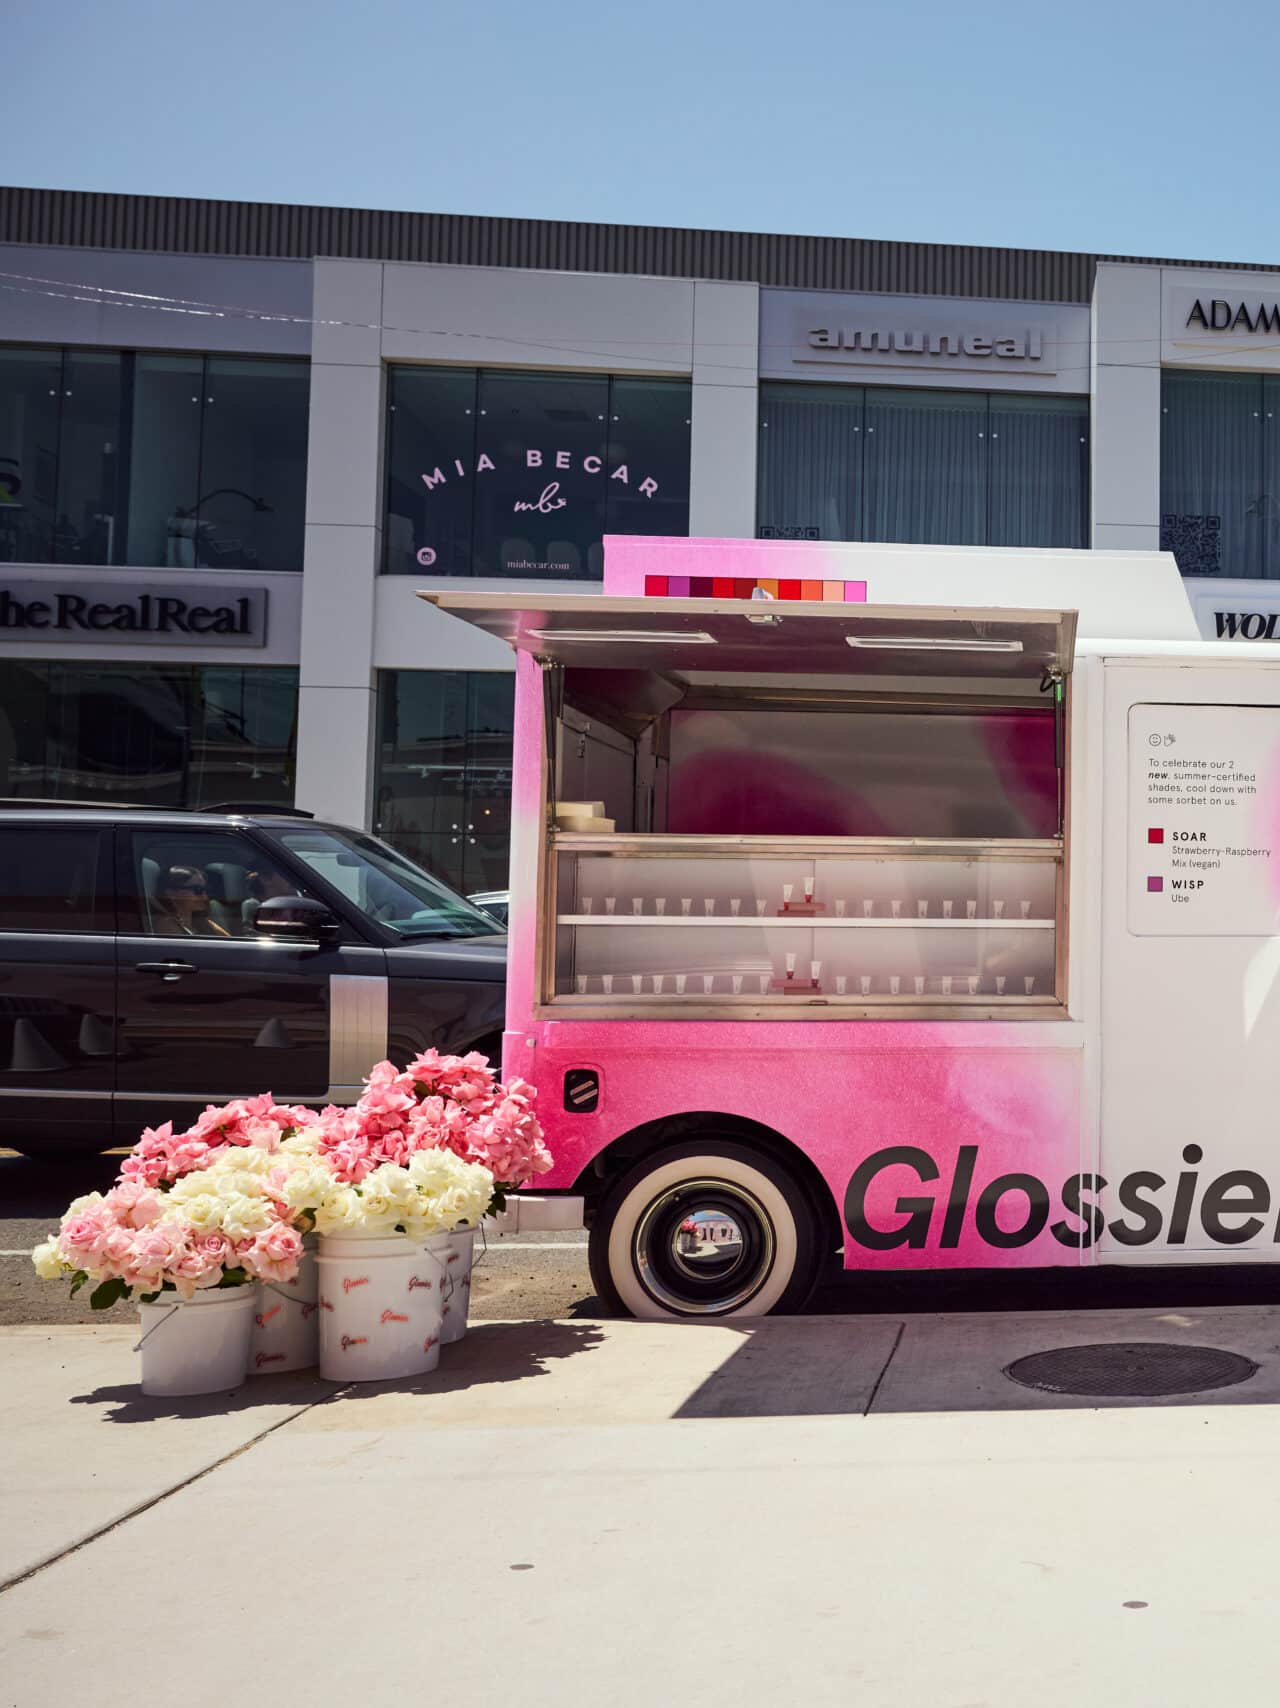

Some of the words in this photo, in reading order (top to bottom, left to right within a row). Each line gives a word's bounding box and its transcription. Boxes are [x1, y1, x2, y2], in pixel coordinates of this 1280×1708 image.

[808, 327, 1042, 361] amuneal
[421, 453, 496, 490] MIA
[526, 449, 659, 498] BECAR
[1149, 758, 1160, 768] To
[1162, 759, 1208, 769] celebrate
[1210, 761, 1226, 769] our
[1228, 760, 1235, 769] 2
[1173, 772, 1256, 782] summer-certified
[1148, 783, 1183, 793] shades,
[1185, 784, 1207, 793] cool
[1209, 785, 1235, 793] down
[1237, 785, 1257, 794] with
[1148, 797, 1173, 805] some
[1176, 796, 1207, 805] sorbet
[1172, 831, 1207, 842] SOAR
[1171, 845, 1272, 857] Strawberry-Raspberry
[1171, 859, 1187, 868] Mix
[1189, 859, 1221, 870] (vegan)
[1171, 879, 1205, 889] WISP
[1171, 894, 1190, 903] Ube
